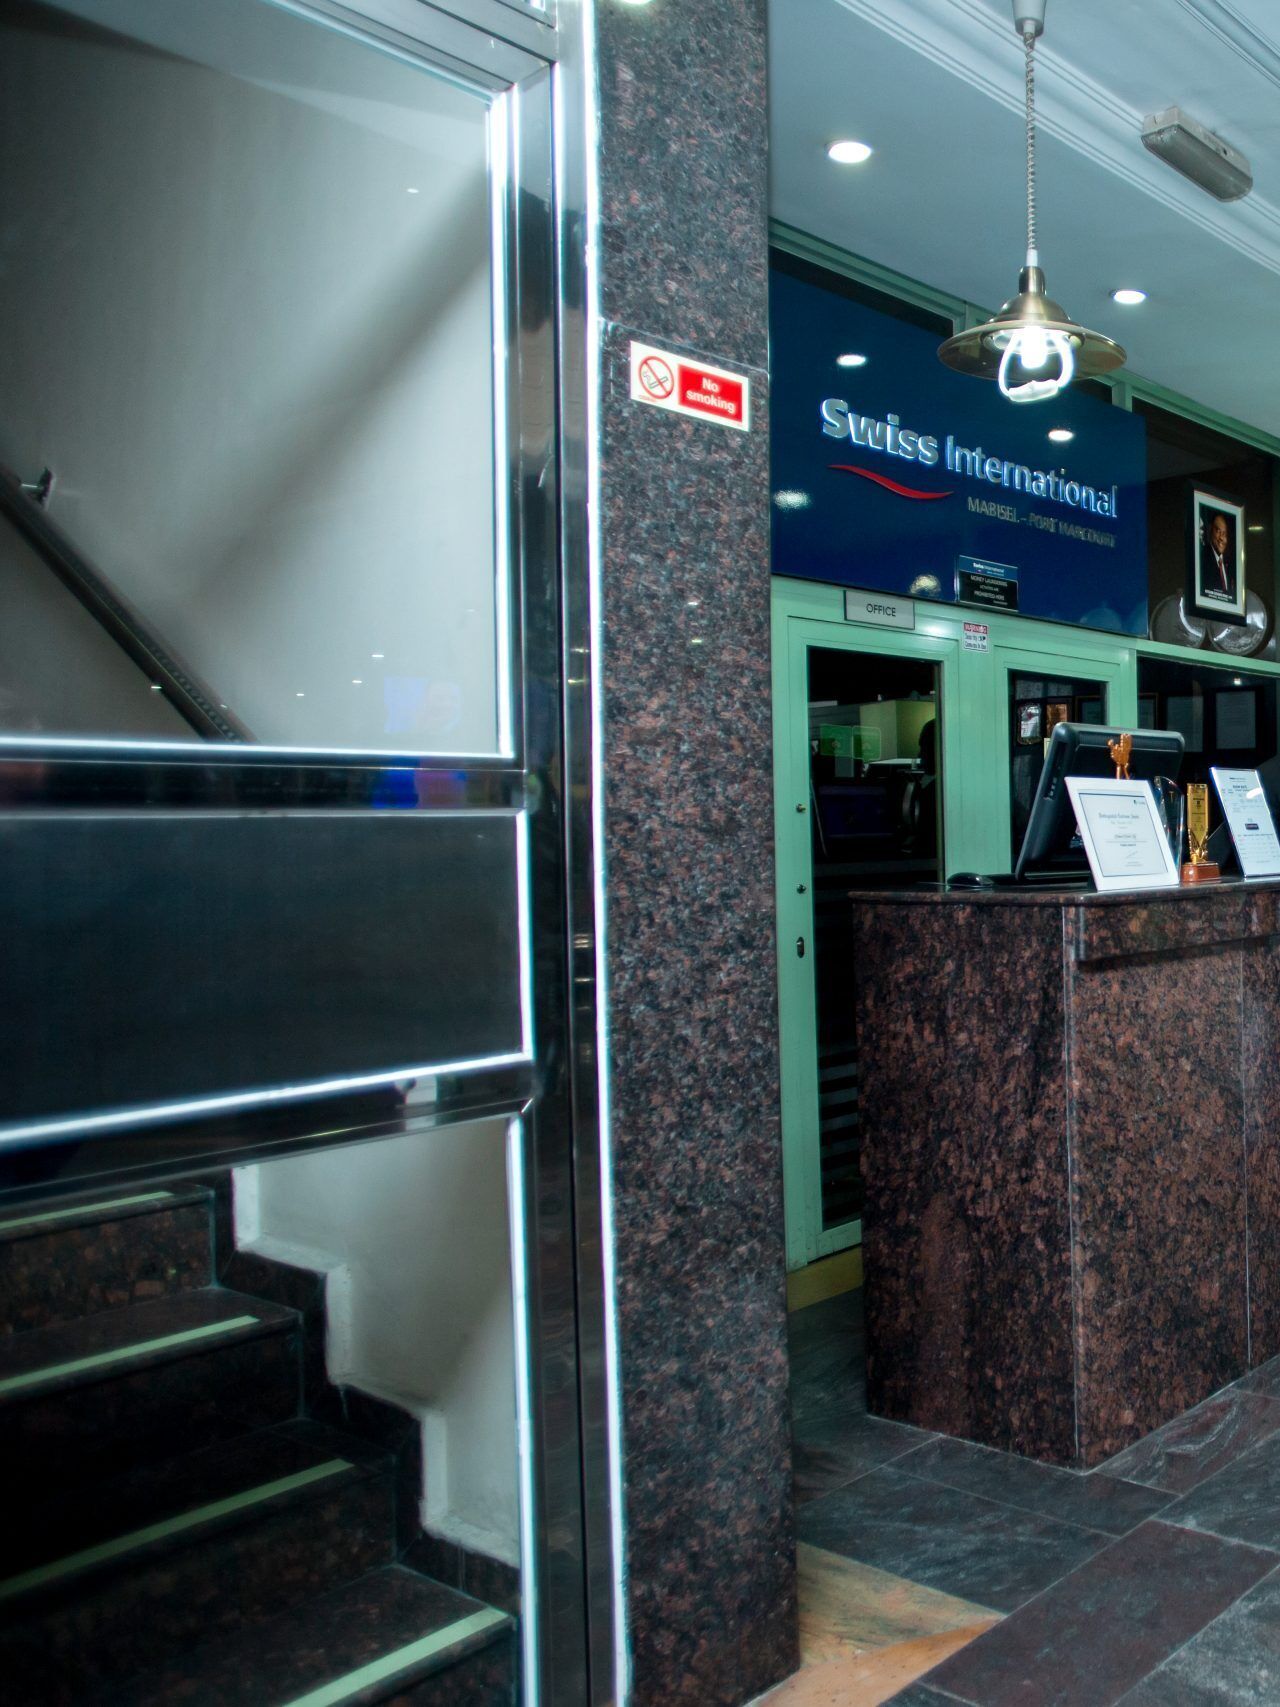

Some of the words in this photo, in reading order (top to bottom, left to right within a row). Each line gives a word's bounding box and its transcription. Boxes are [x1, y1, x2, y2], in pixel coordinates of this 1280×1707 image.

[702, 377, 720, 393] No
[686, 390, 736, 414] smoking
[820, 398, 939, 464] Swiss
[945, 435, 1118, 518] International
[866, 603, 897, 617] OFFICE
